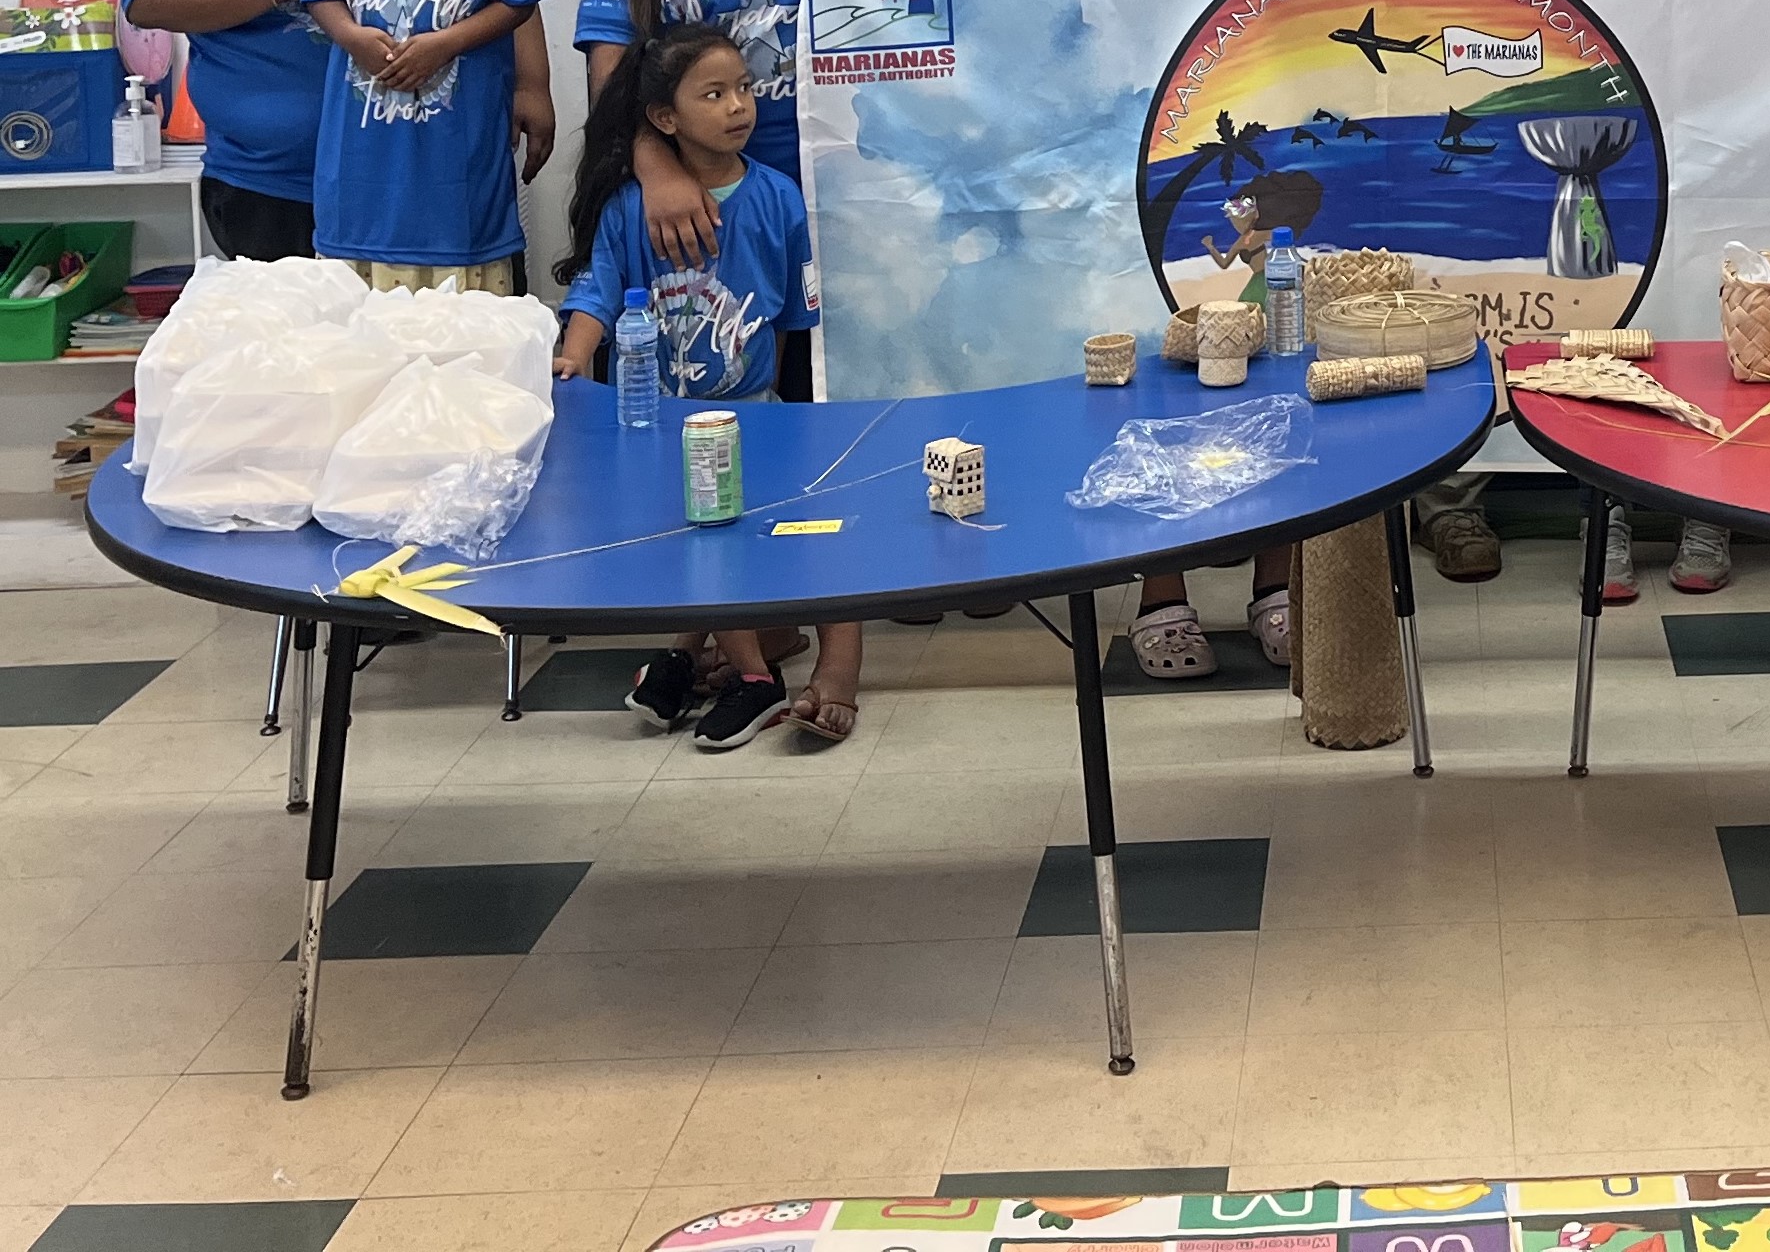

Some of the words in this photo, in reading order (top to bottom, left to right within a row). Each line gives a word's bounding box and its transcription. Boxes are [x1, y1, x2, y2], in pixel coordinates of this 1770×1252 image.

[812, 47, 956, 73] MARIANAS
[1466, 43, 1482, 59] THE
[1484, 43, 1538, 60] MARIANAS
[814, 71, 876, 85] VISITORS
[878, 67, 955, 81] AUTHORITY
[1514, 291, 1554, 330] IS
